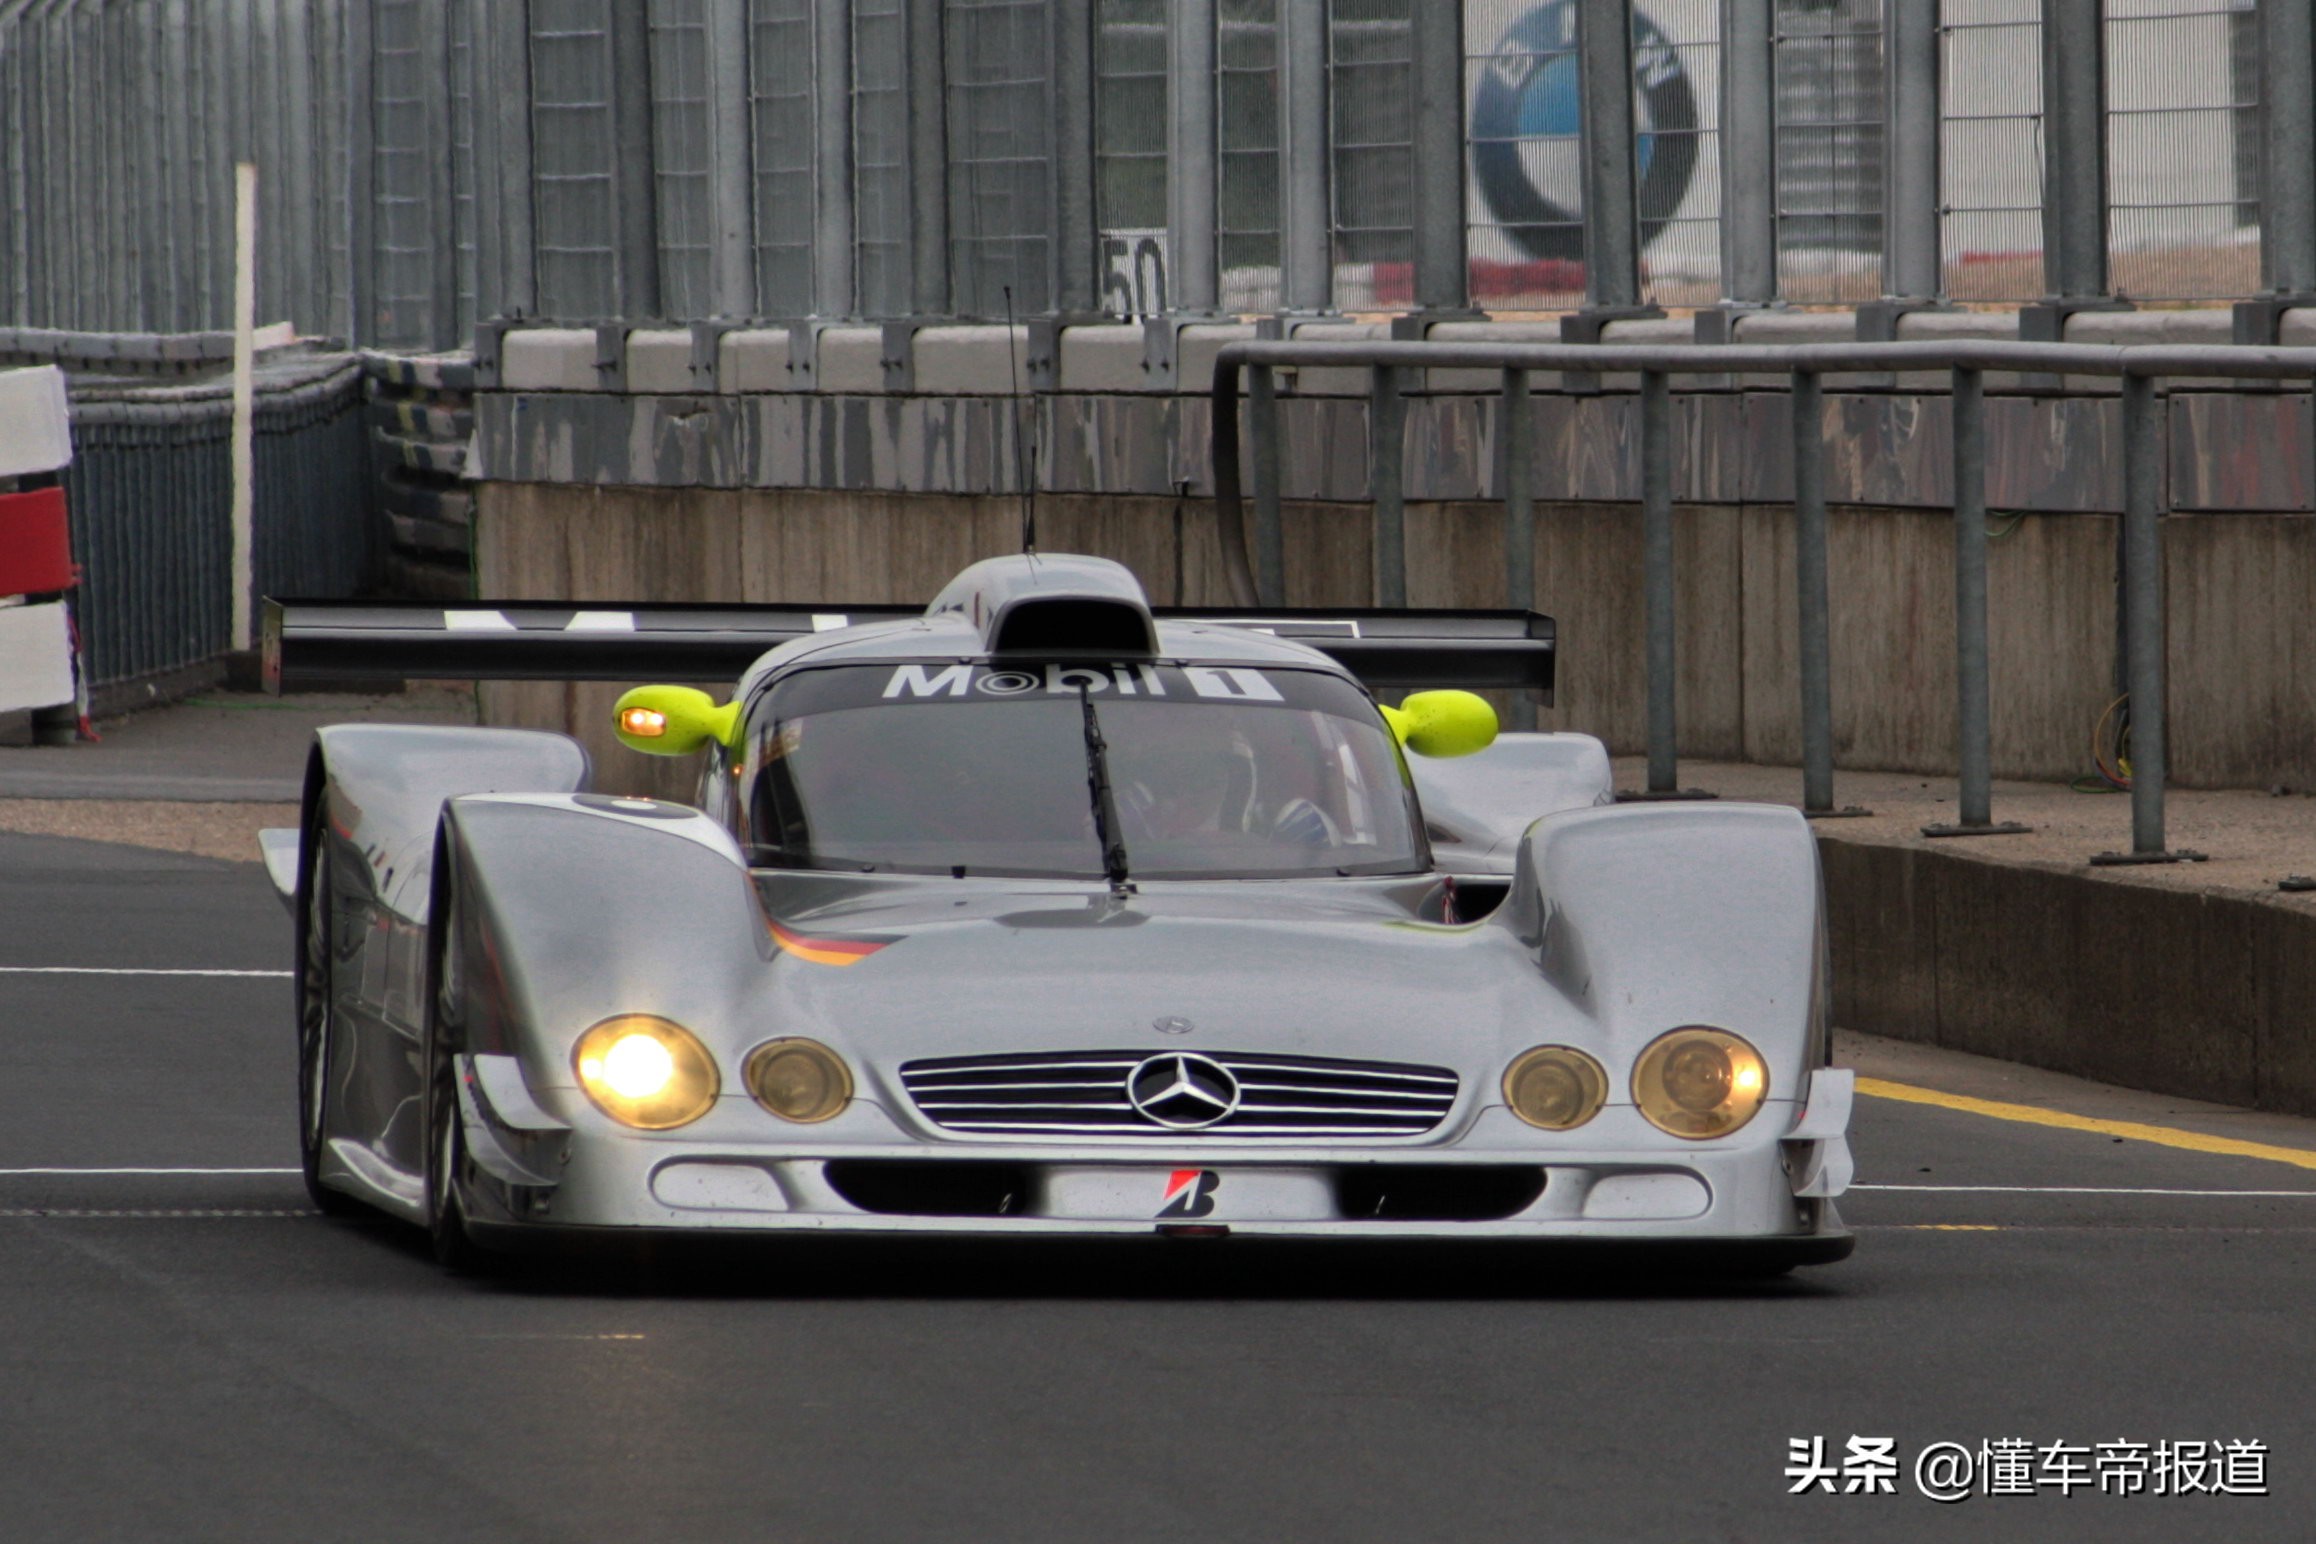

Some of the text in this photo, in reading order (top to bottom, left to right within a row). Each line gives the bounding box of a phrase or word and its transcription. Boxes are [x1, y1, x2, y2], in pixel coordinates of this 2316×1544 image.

[1491, 4, 1681, 89] BW
[1103, 238, 1167, 323] 50
[882, 662, 1167, 699] Mobil
